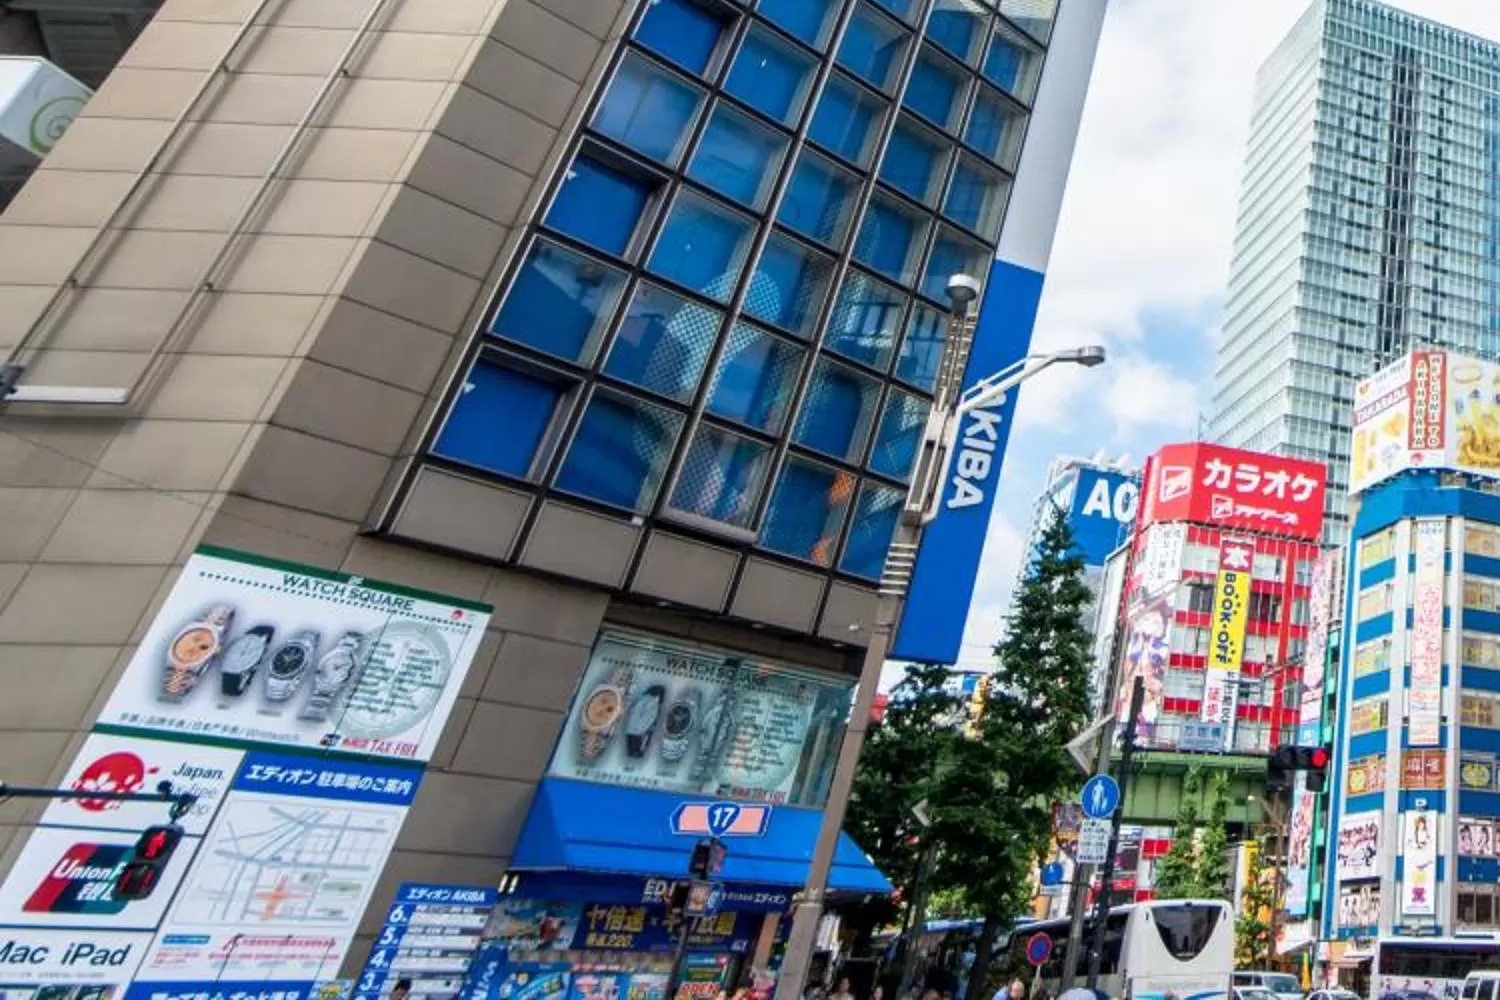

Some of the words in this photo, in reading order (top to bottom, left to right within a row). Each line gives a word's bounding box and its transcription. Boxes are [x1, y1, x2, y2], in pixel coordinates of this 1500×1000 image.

[1203, 456, 1318, 502] カラオケ
[1222, 545, 1250, 569] 本
[281, 573, 347, 601] WATCH
[348, 585, 416, 612] SQUARE
[245, 764, 317, 786] エディオン
[712, 807, 736, 828] 17
[53, 858, 128, 880] UnionP
[60, 942, 132, 966] iPad
